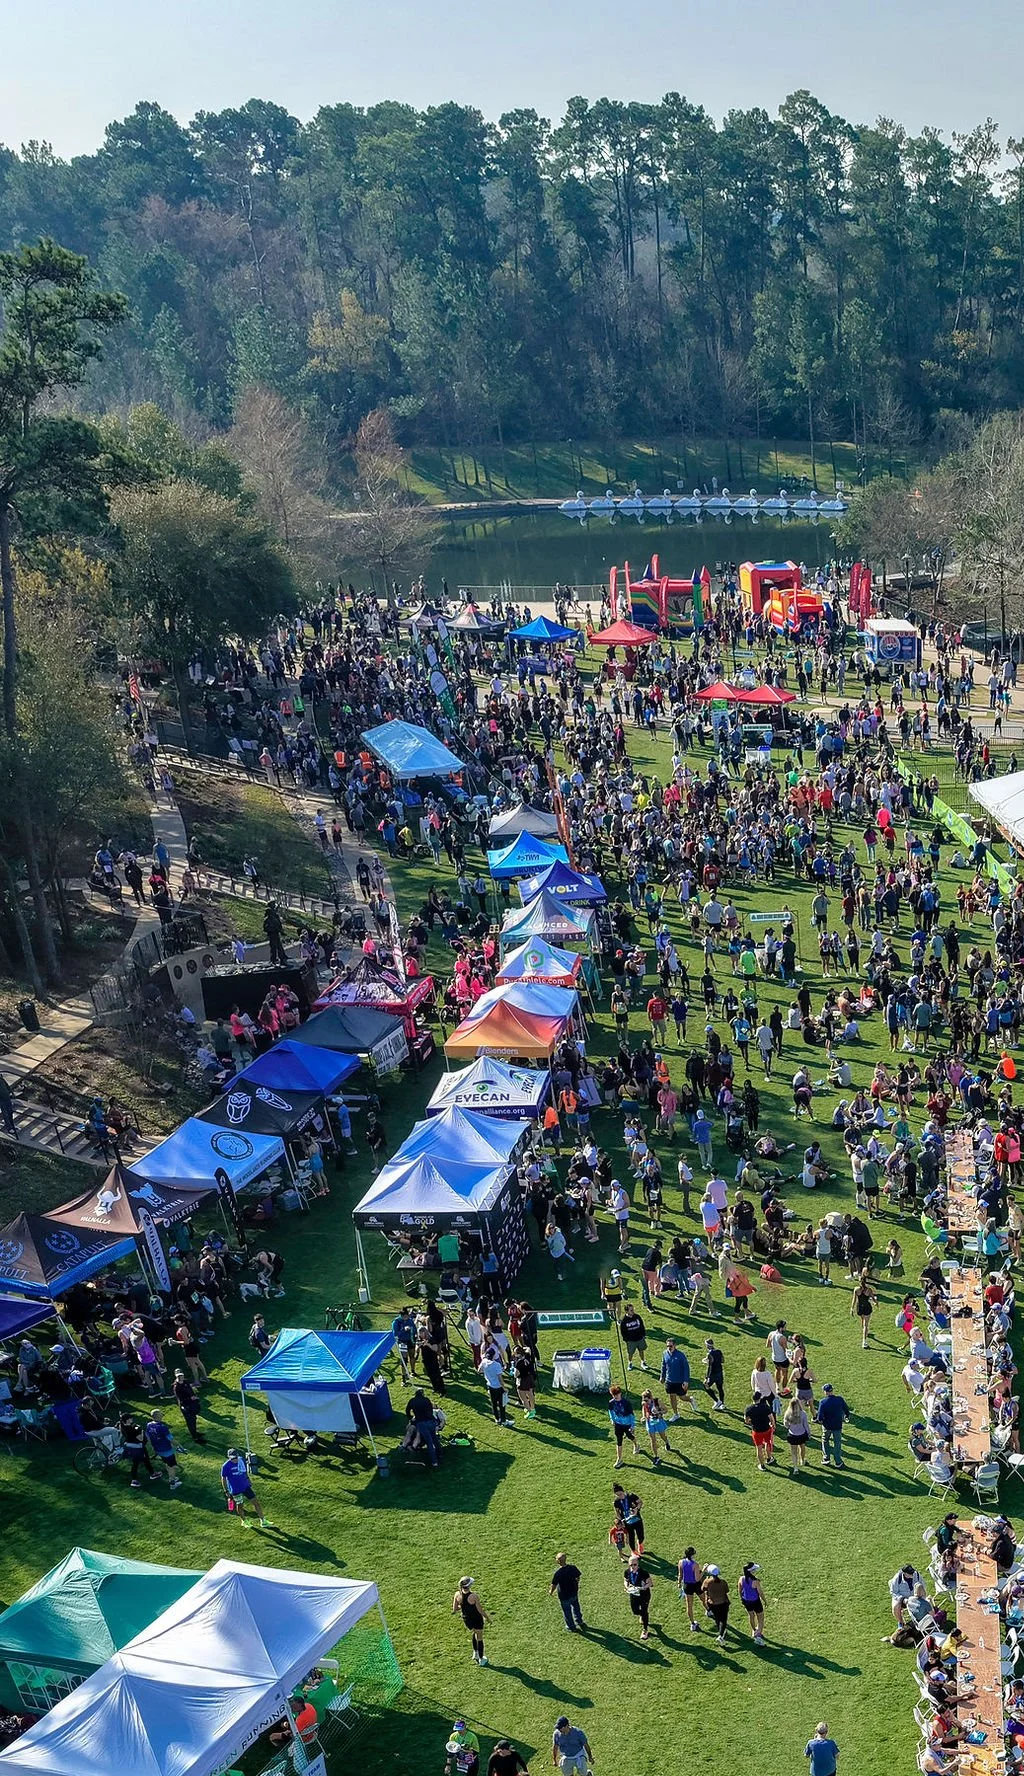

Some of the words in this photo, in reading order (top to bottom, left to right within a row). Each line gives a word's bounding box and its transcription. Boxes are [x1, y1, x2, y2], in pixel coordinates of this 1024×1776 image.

[546, 884, 579, 894] VOLT
[485, 1047, 519, 1055] Blenders
[455, 1093, 510, 1103] EYECAN
[151, 1199, 185, 1218] VALKYRIE
[169, 1201, 200, 1223] VALKYRIE
[56, 1239, 110, 1272] CATAPULT
[149, 1227, 168, 1286] VALHALLA
[308, 1763, 321, 1776] TEAM
